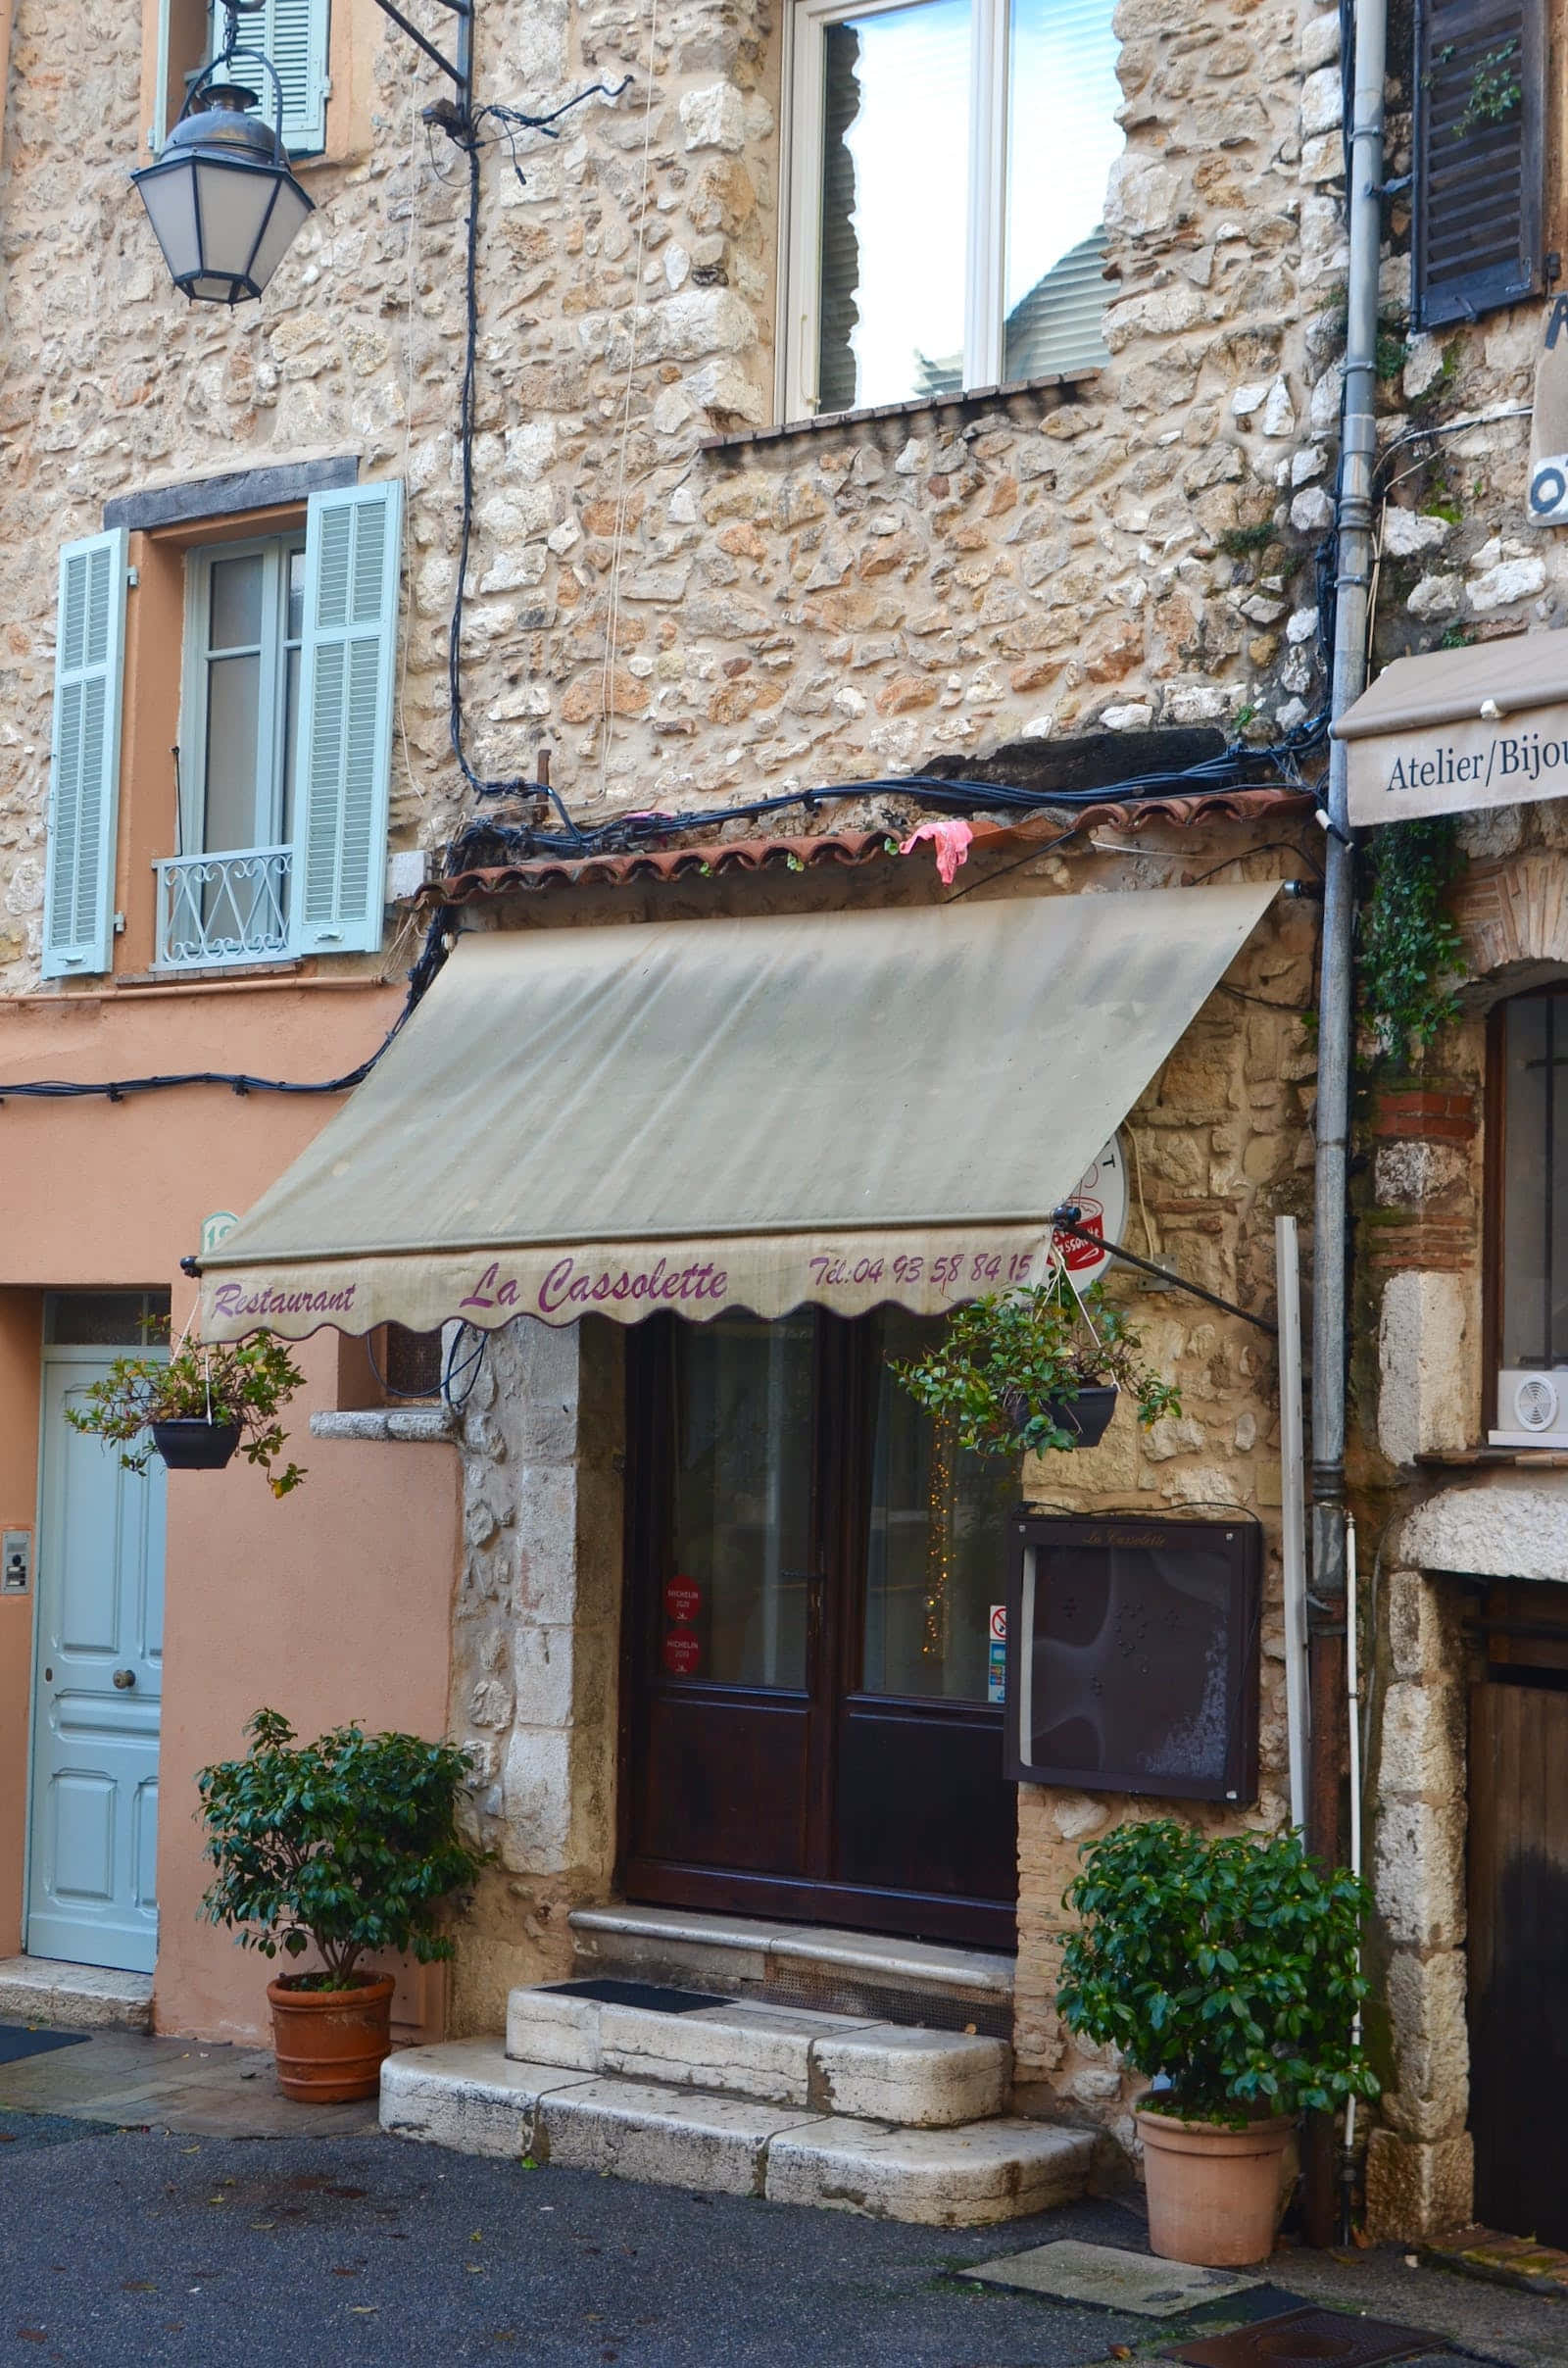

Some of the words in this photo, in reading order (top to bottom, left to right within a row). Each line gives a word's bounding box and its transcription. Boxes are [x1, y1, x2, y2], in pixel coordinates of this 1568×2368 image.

[893, 1255, 924, 1284] 93
[930, 1254, 964, 1283] 58
[970, 1254, 1002, 1282] 84
[1008, 1253, 1034, 1282] 15
[211, 1282, 356, 1319] Restaurant
[460, 1261, 520, 1309] La
[538, 1257, 728, 1313] Cassolette
[666, 1588, 699, 1601] MICHELIN
[666, 1638, 699, 1650] MICHELIN
